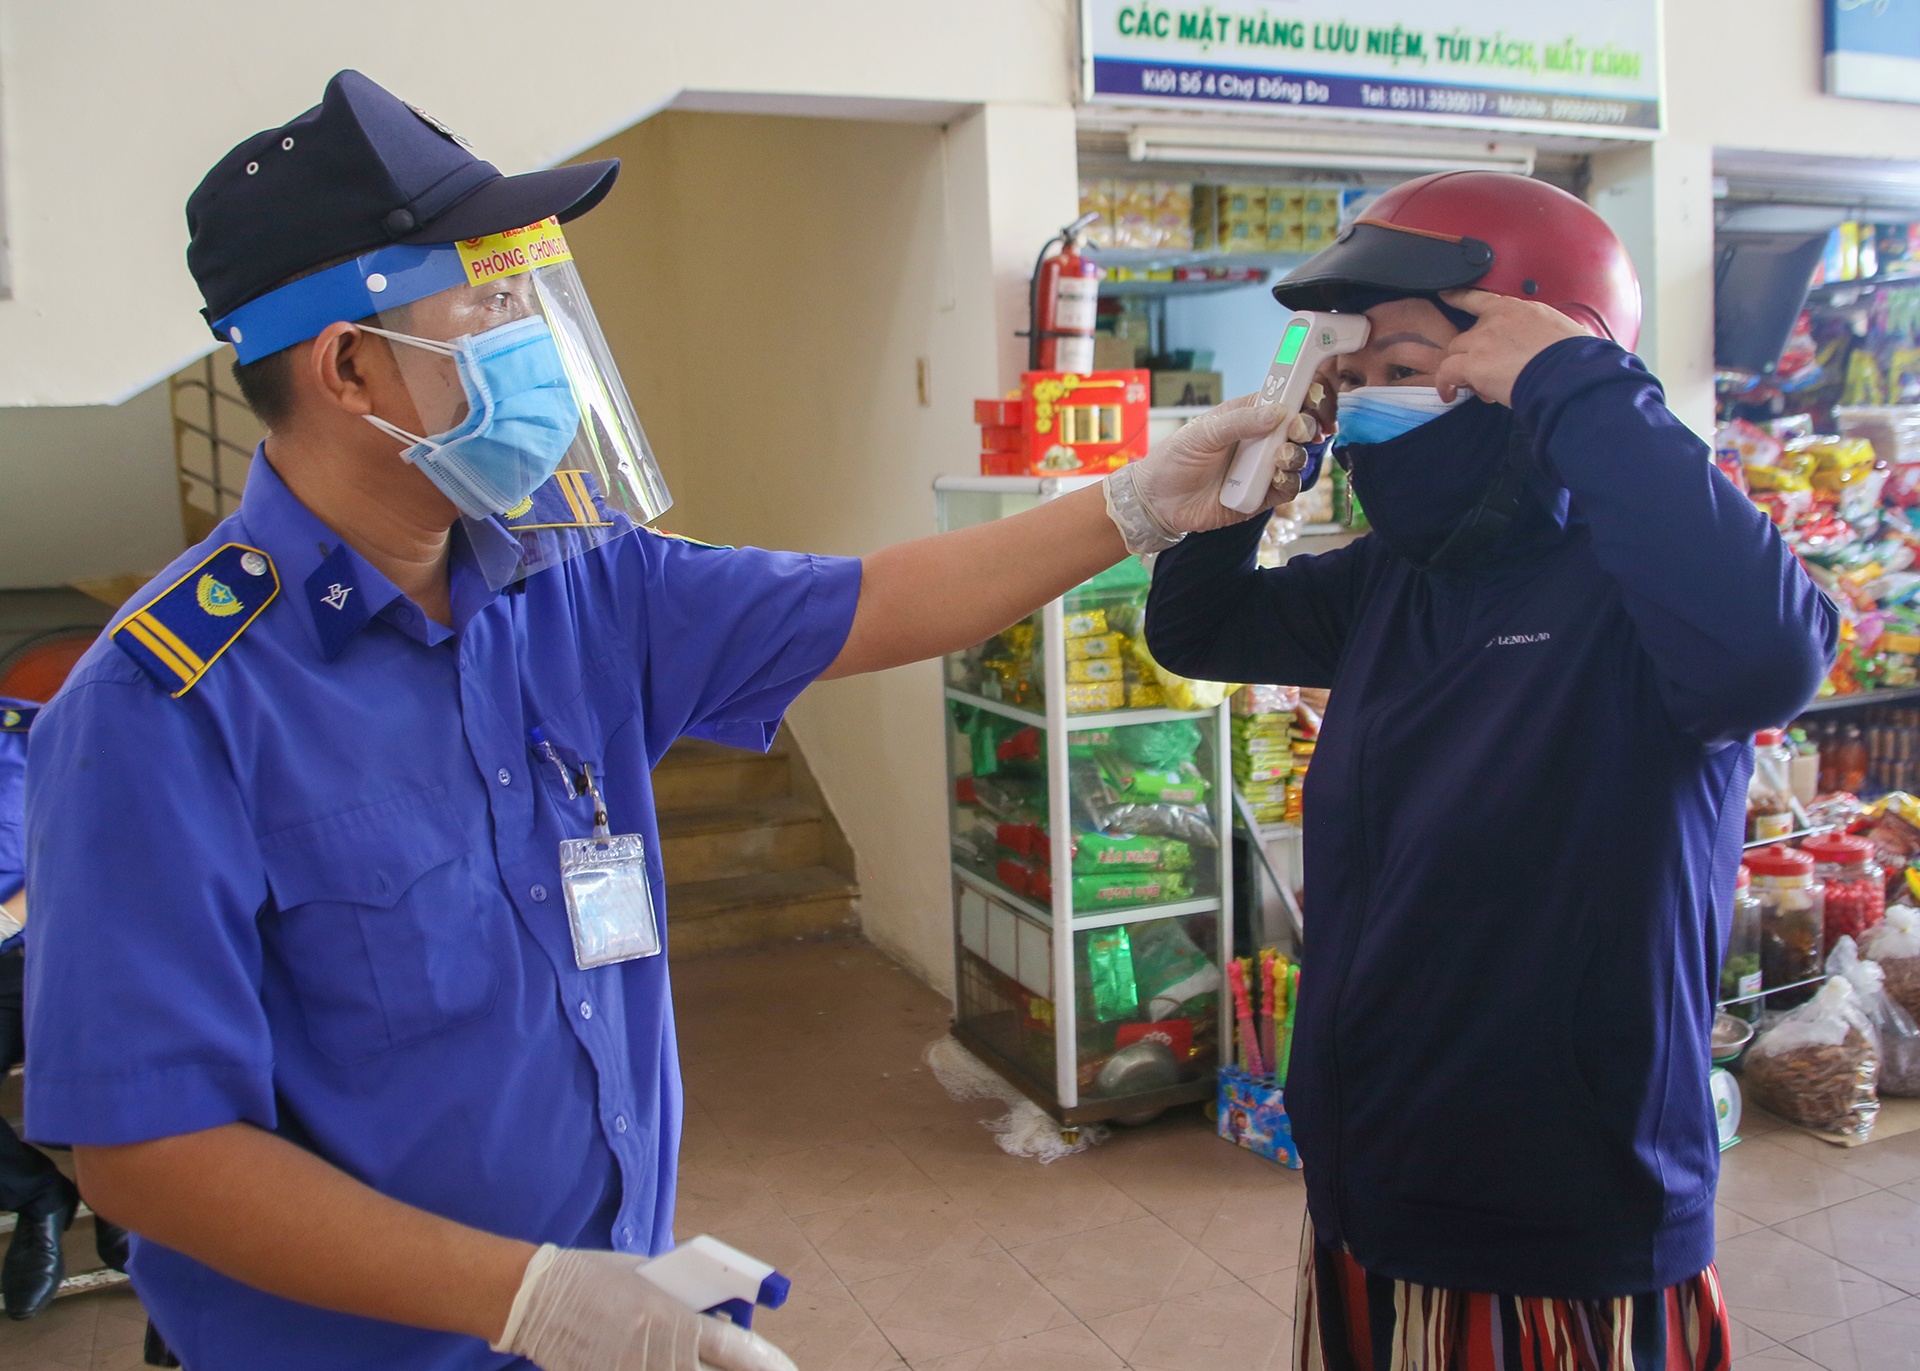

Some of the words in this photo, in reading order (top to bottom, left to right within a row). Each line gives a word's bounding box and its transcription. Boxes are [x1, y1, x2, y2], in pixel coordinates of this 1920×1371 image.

[1118, 3, 1170, 38] CÁC
[1178, 7, 1230, 50] MẶT
[1239, 11, 1304, 49] HÀNG
[1314, 20, 1359, 51] LƯU
[1367, 24, 1427, 67] NIỆM,
[1435, 28, 1470, 63] TÚI
[1478, 32, 1538, 75] XÁCH,
[1204, 74, 1216, 94] 4
[1218, 74, 1255, 100] Chợ
[1257, 76, 1302, 104] Đống
[1304, 80, 1329, 103] Đa
[1361, 83, 1388, 107] Tel:
[471, 248, 529, 279] PHÒNG,
[529, 234, 560, 261] CHỐNG
